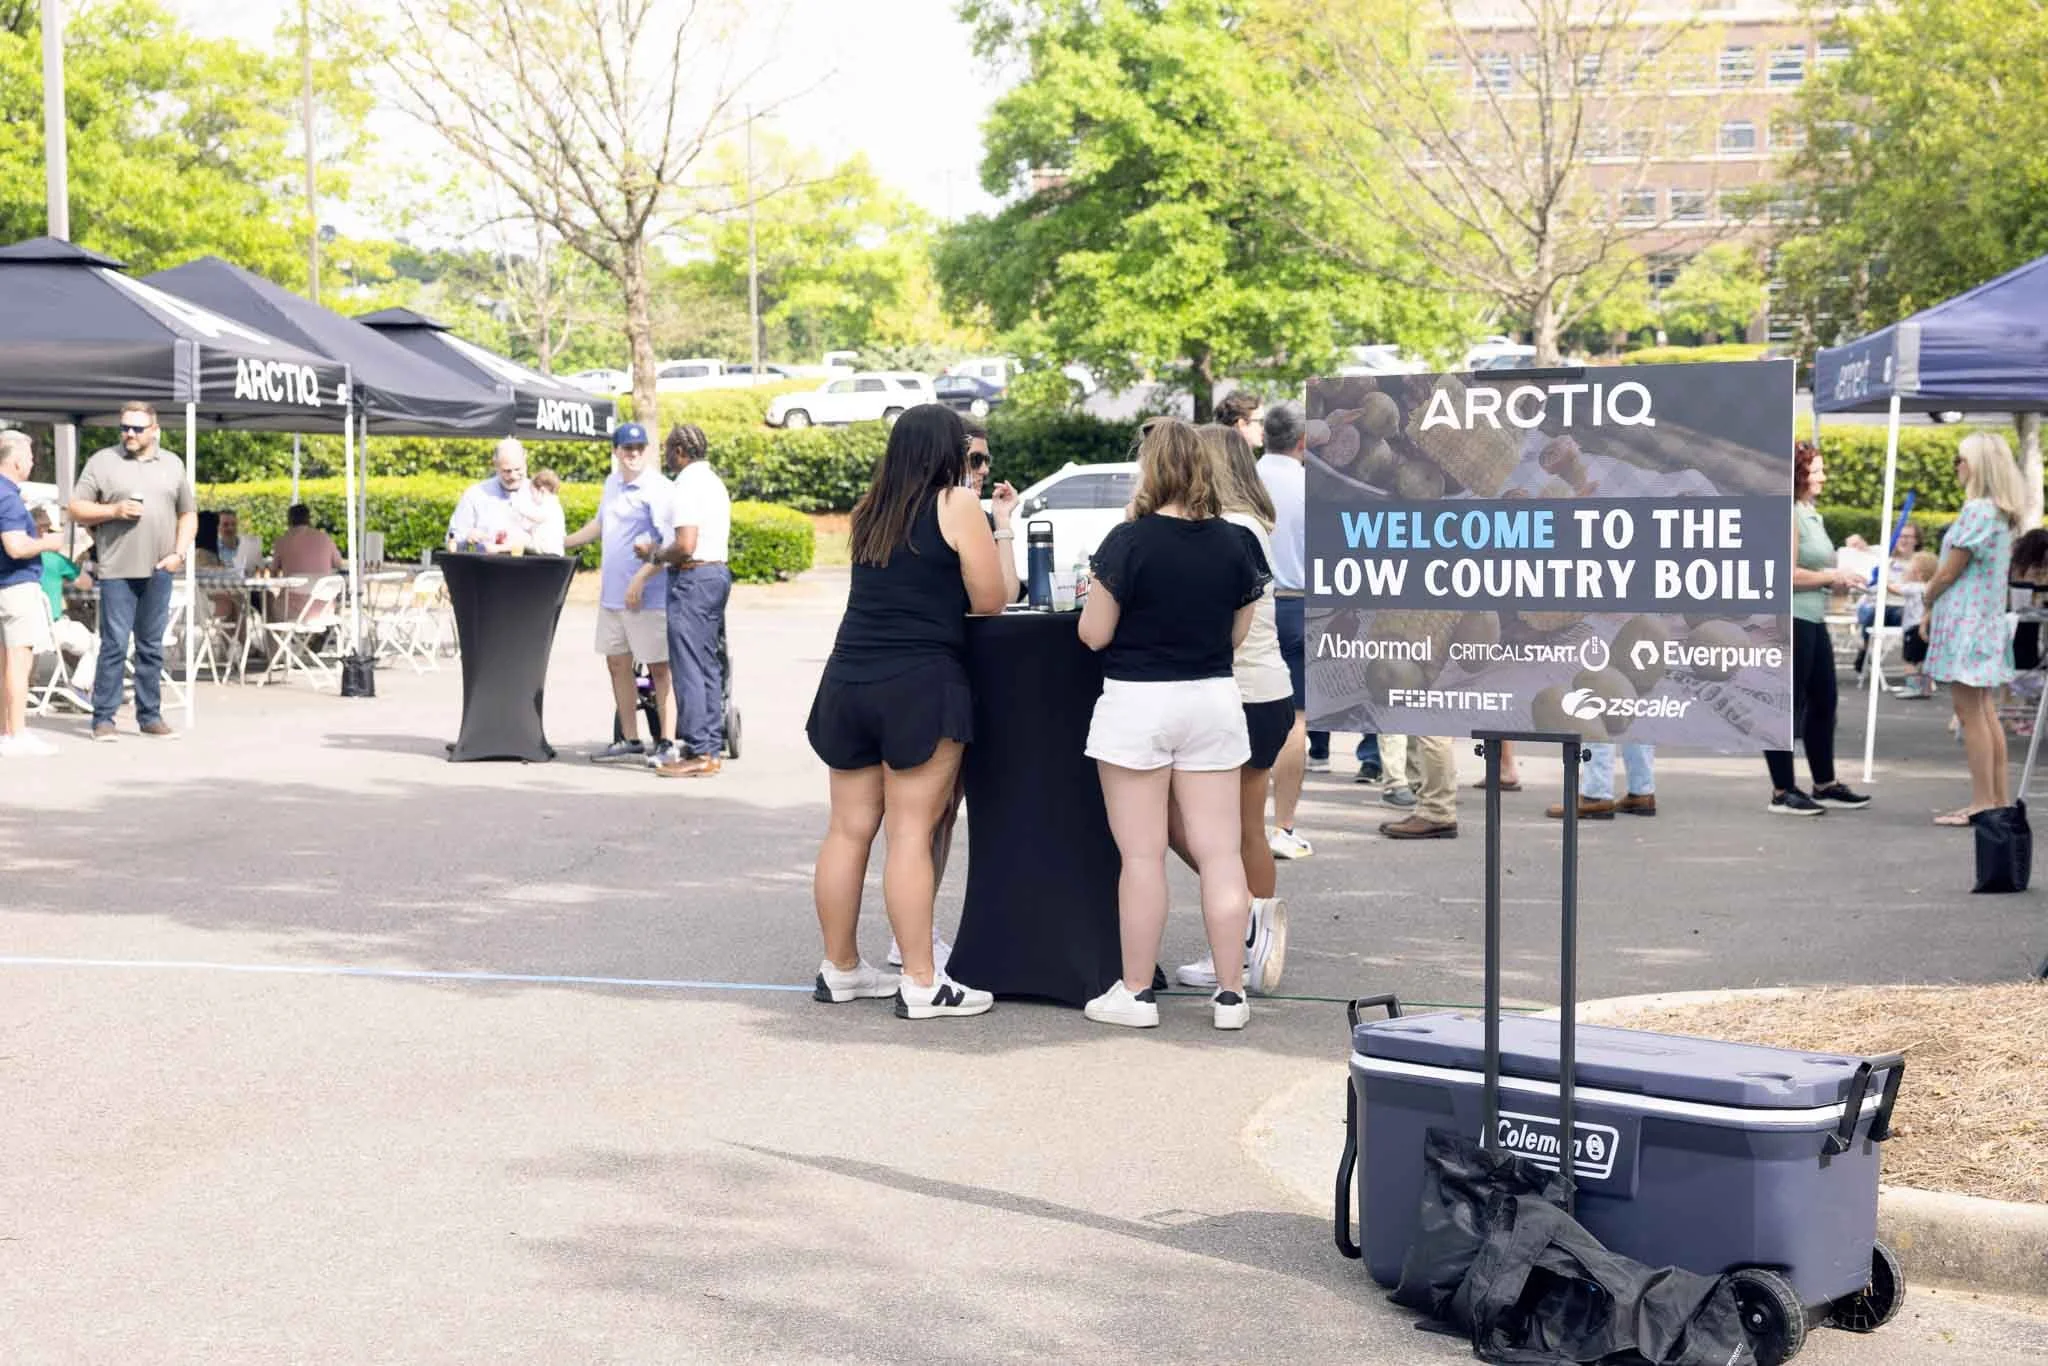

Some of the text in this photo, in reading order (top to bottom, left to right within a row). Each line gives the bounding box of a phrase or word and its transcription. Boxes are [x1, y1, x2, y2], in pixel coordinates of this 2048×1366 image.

[235, 358, 321, 407] ARCTIQ
[536, 398, 596, 436] ARCTIQ
[1420, 382, 1656, 431] ARCTIQ
[1341, 509, 1743, 549] WELCOME TO THE
[1313, 558, 1776, 600] LOW COUNTRY BOIL!
[1316, 633, 1432, 661] Abnormal
[1663, 640, 1783, 672] Everpure
[1388, 688, 1513, 711] FORTINET
[1606, 696, 1691, 719] zscaler
[1498, 1119, 1582, 1158] Colemn
